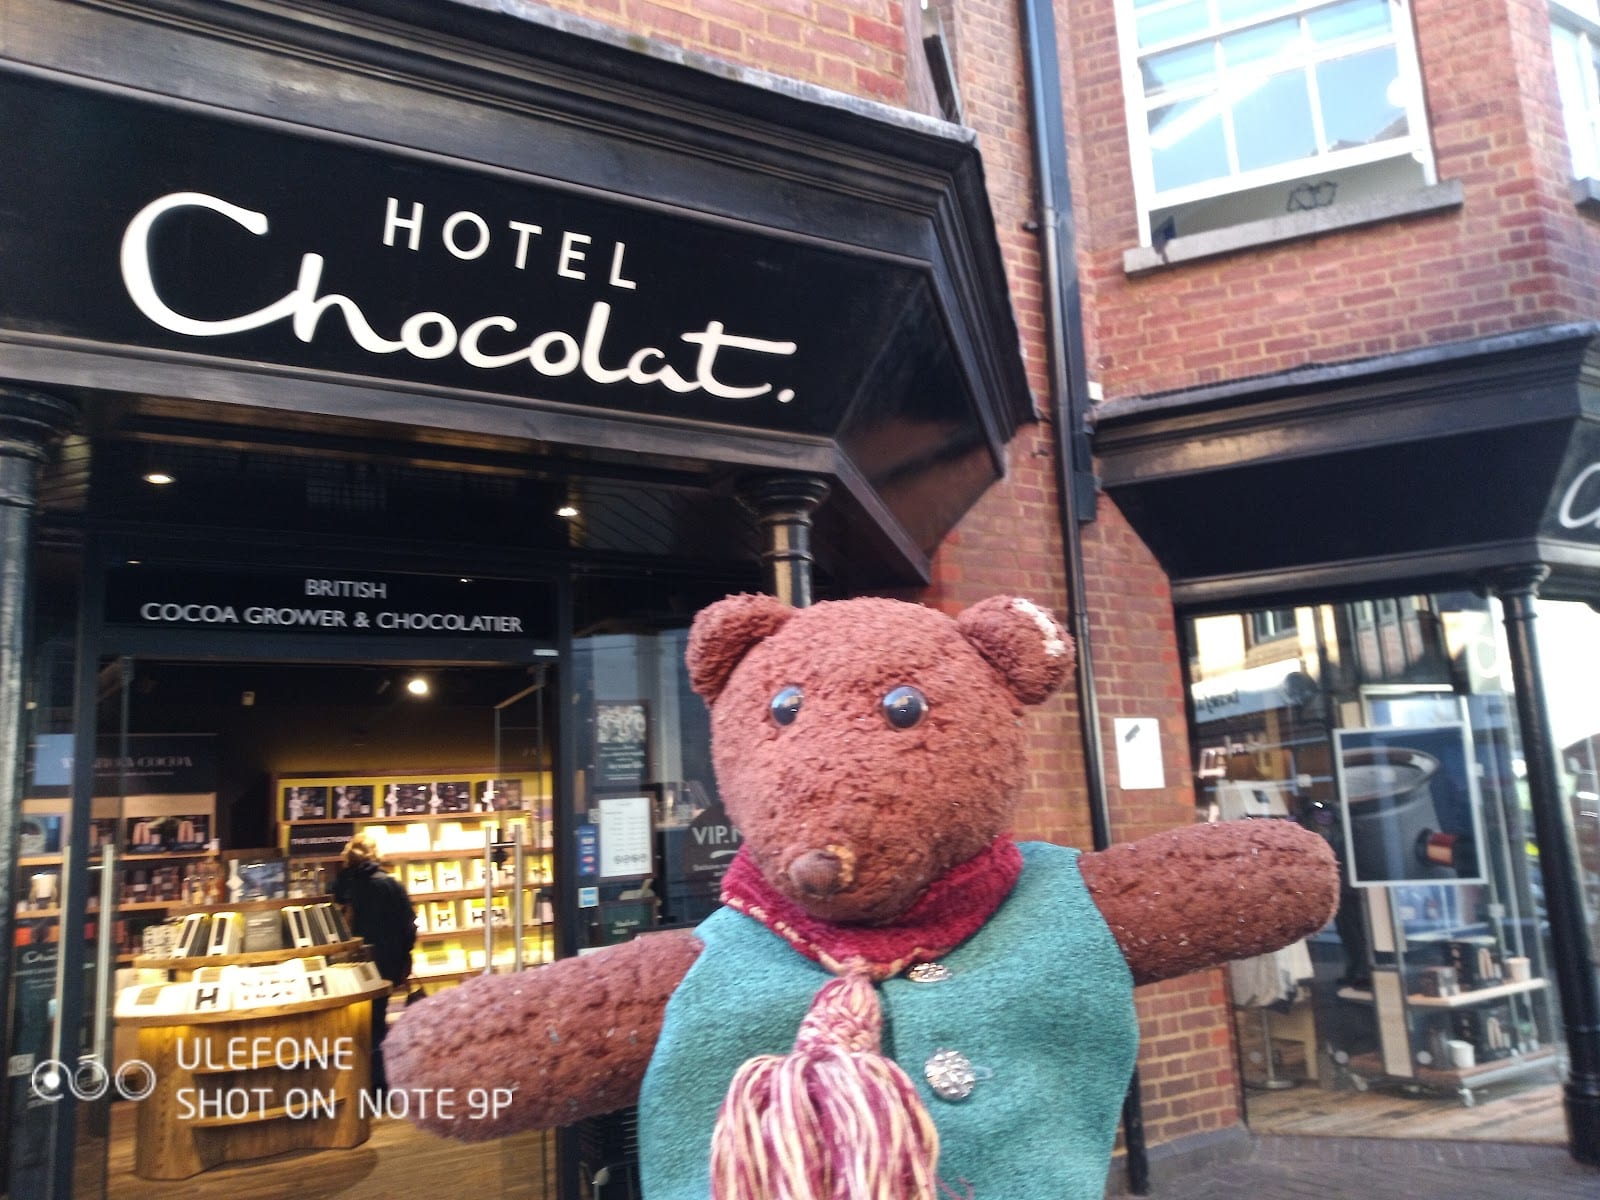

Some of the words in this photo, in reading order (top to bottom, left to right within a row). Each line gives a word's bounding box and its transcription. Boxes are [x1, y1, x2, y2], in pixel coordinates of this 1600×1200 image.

[382, 197, 637, 290] HOTEL
[304, 578, 387, 599] BRITISH
[140, 602, 240, 623] COCOA
[243, 606, 348, 628] GROWER
[352, 611, 371, 629] &
[376, 612, 524, 633] CHOCOLATIER
